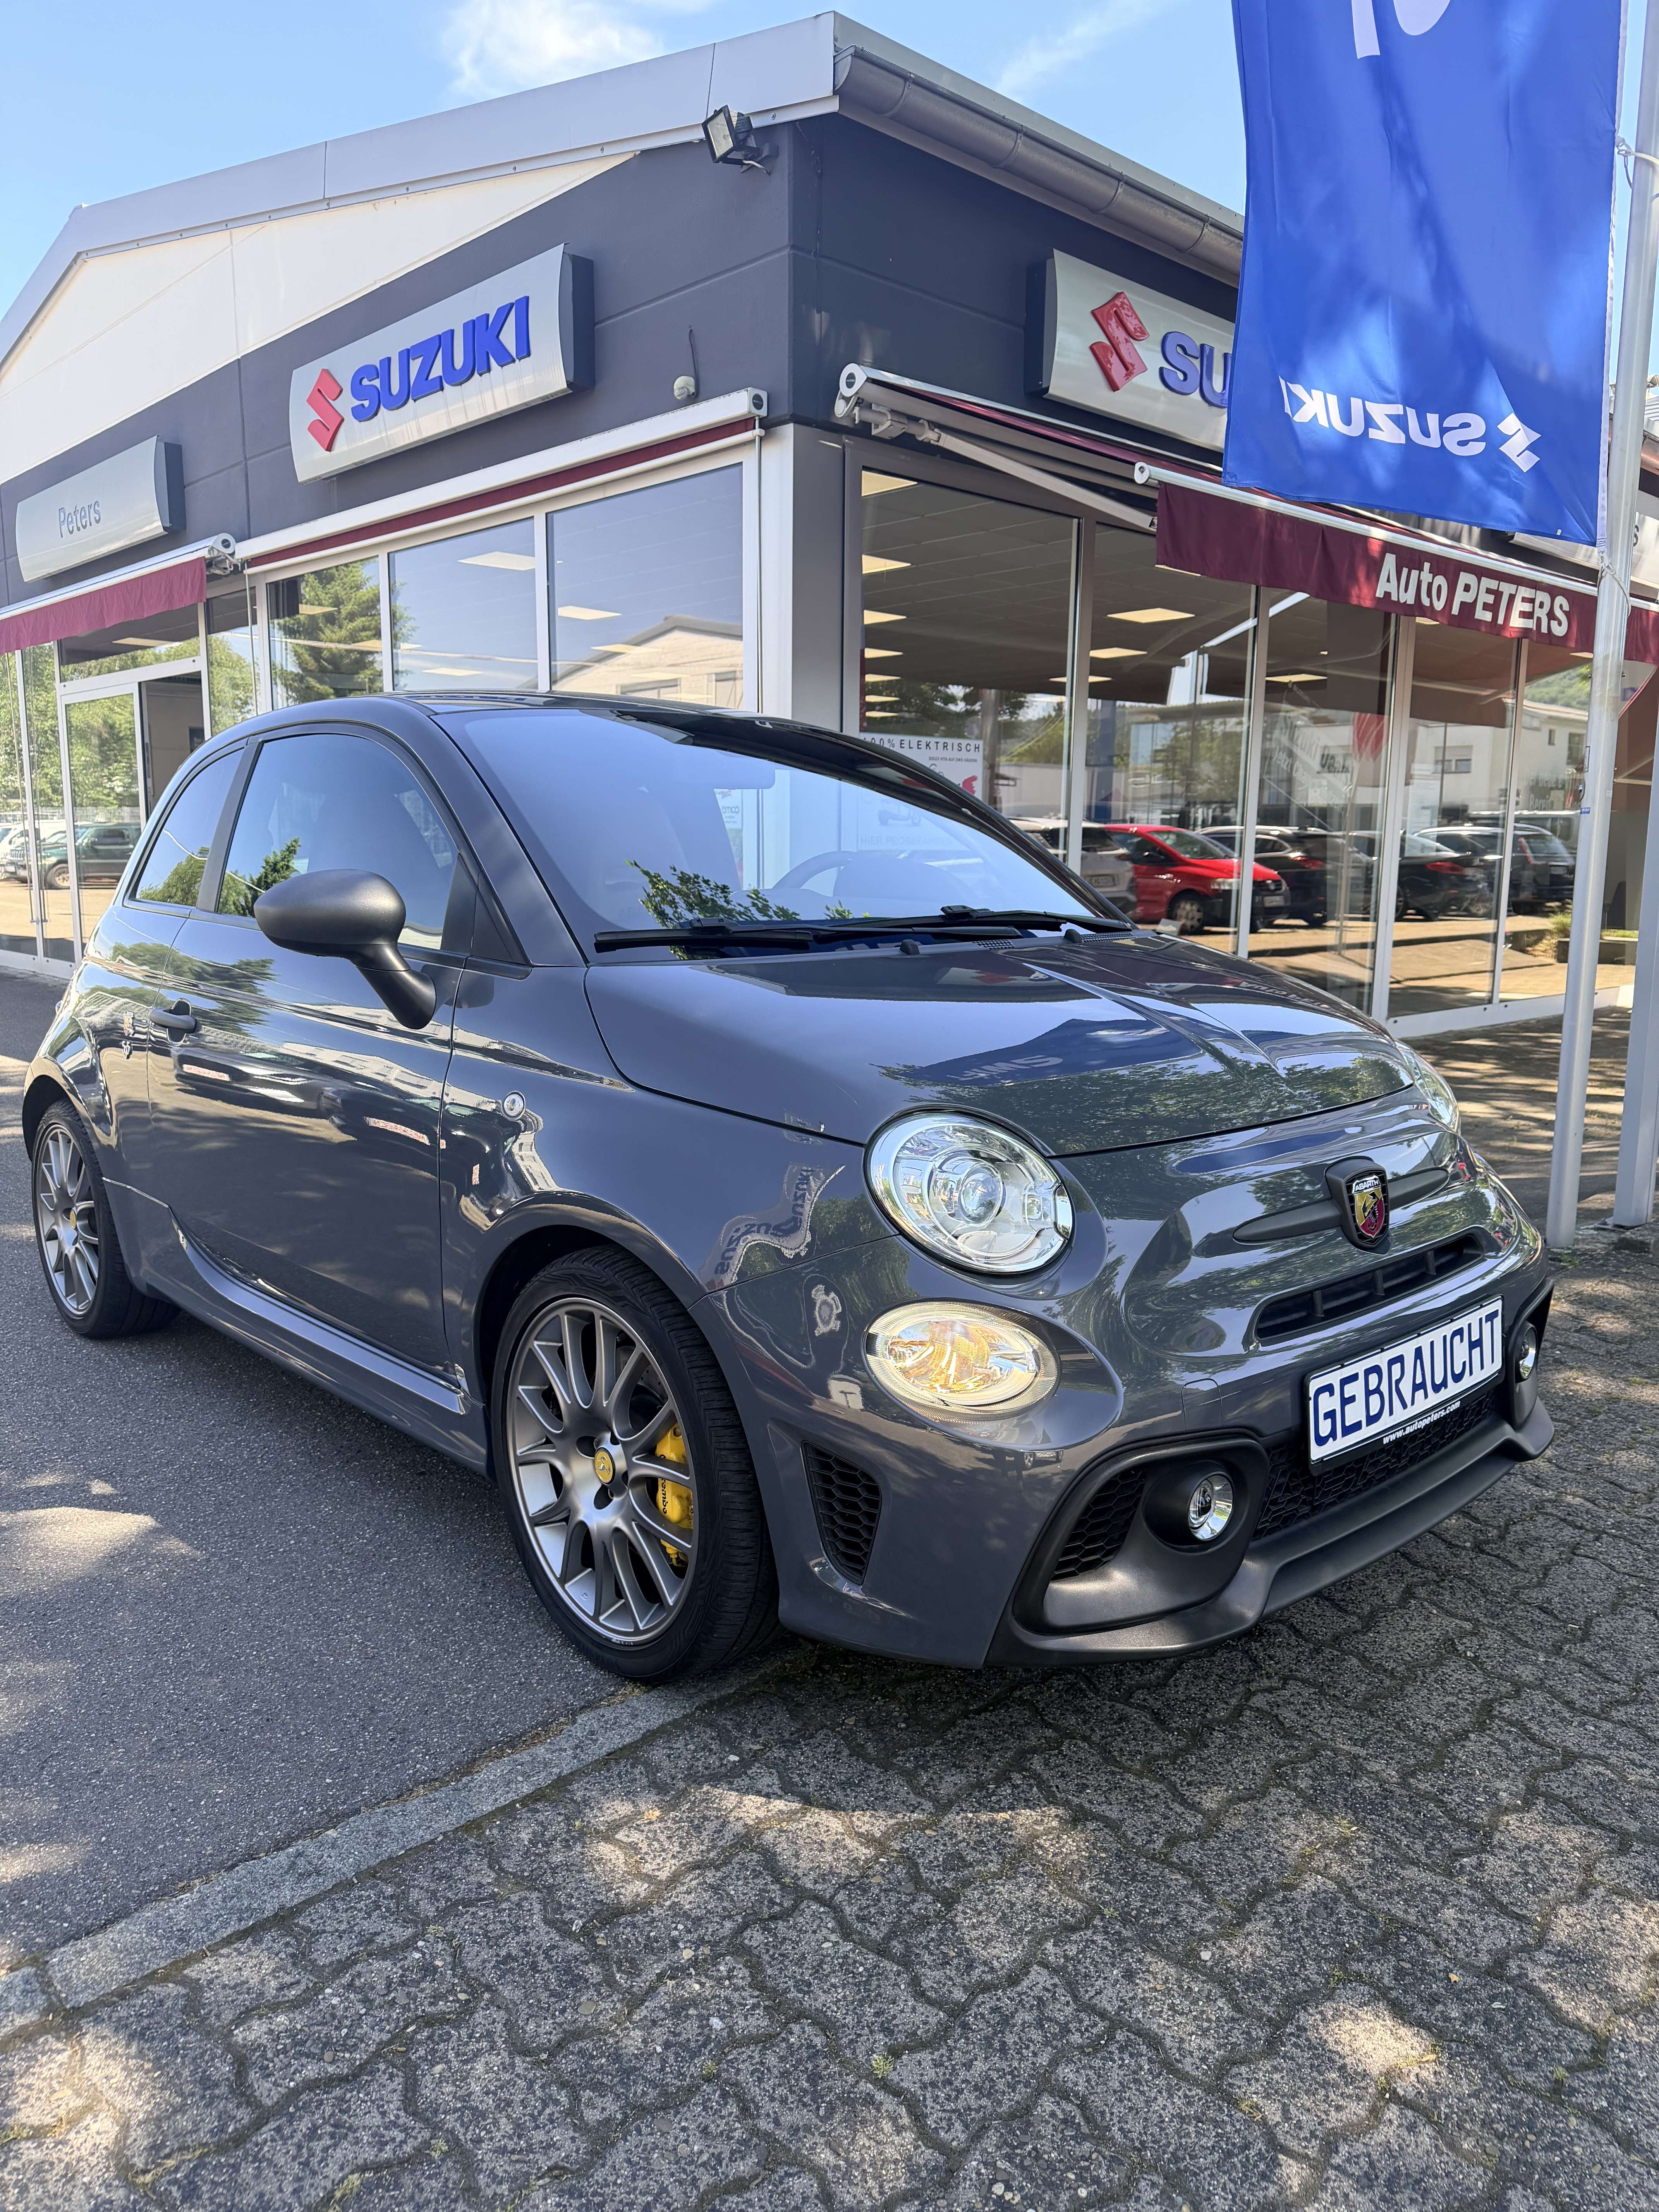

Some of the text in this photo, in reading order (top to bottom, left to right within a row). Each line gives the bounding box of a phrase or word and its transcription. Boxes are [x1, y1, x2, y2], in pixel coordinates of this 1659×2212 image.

[351, 296, 530, 422] SUZUKI
[1159, 331, 1233, 408] SU
[58, 500, 101, 538] Peters
[1376, 553, 1570, 637] Auto PETERS
[863, 737, 980, 752] 00% ELEKTRISCH
[1355, 1180, 1379, 1191] ABARTH
[1313, 1309, 1499, 1447] GEBRAUCHT
[1383, 1400, 1461, 1444] www.autopeters.com
